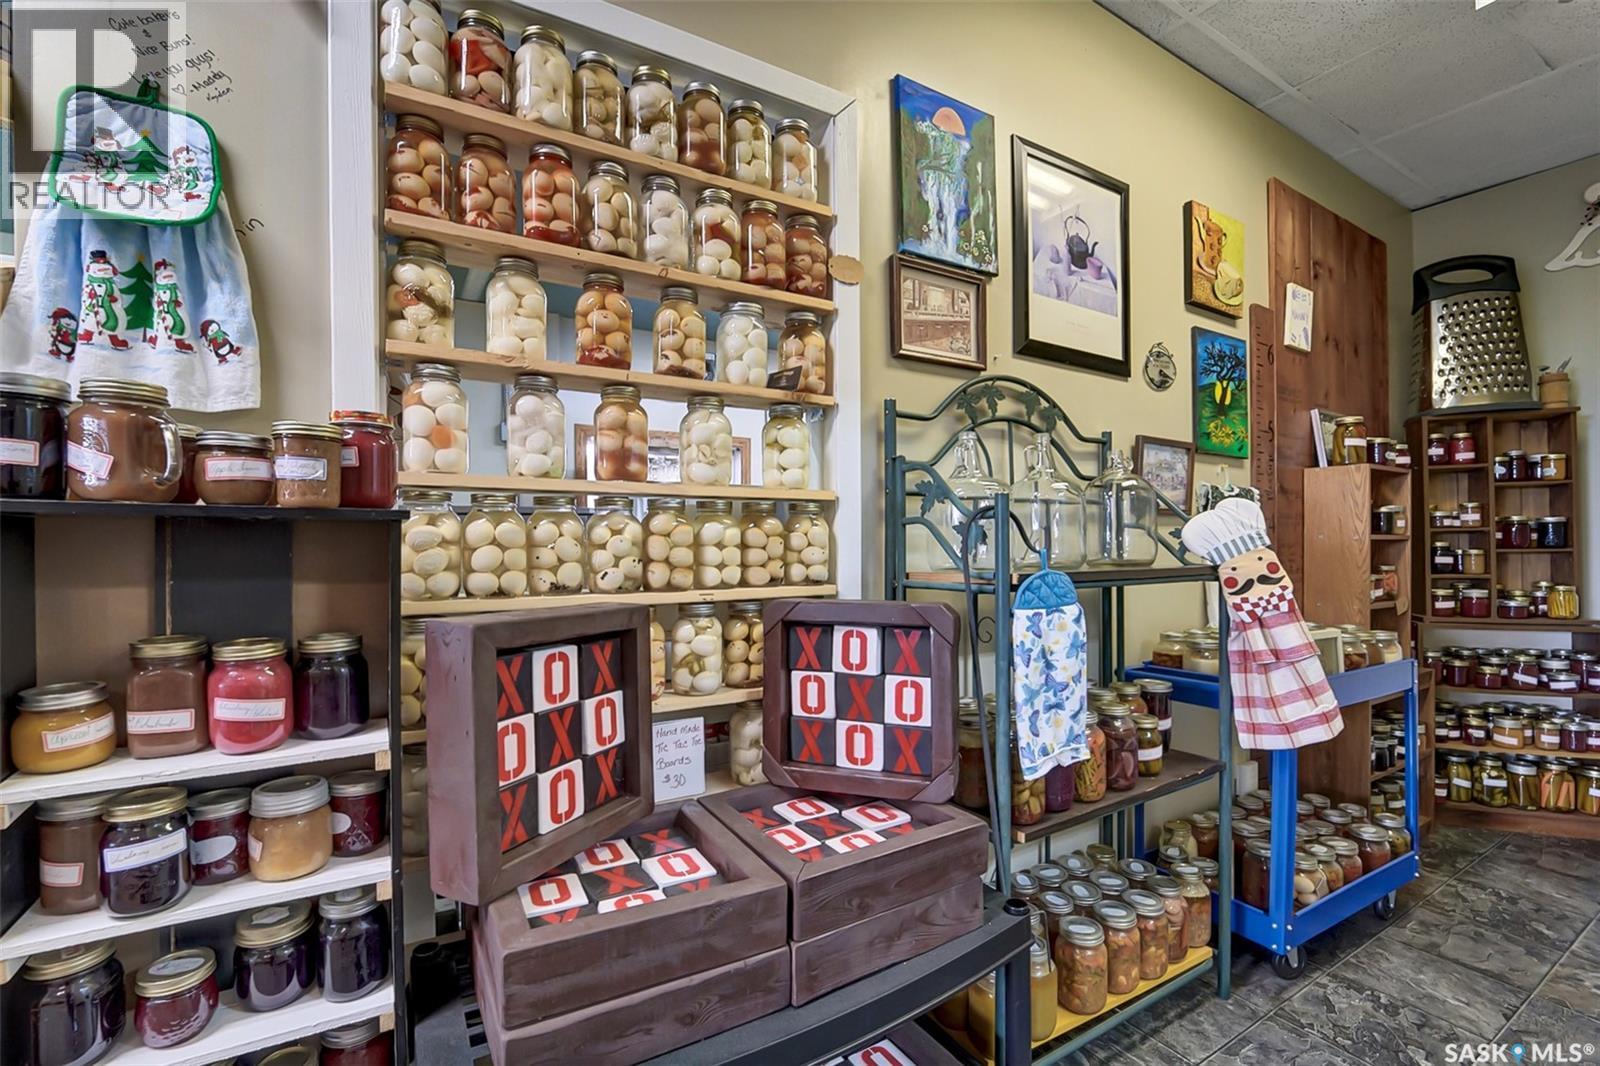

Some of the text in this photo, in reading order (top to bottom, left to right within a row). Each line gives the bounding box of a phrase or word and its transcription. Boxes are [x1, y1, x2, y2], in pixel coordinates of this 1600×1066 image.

[108, 10, 180, 31] Cute bakers
[132, 34, 196, 57] Nice Buns!
[185, 49, 220, 72] guys!
[795, 626, 922, 675] X O X
[496, 638, 616, 718] X O X
[800, 674, 923, 723] O X O
[549, 706, 575, 767] X
[595, 697, 617, 746] O
[655, 734, 703, 753] Tic Tac Toe
[656, 728, 678, 738] Hand
[798, 718, 922, 774] X O X
[656, 757, 692, 770] Boards
[500, 747, 618, 852] X O X
[807, 817, 851, 837] X
[594, 867, 644, 894] X
